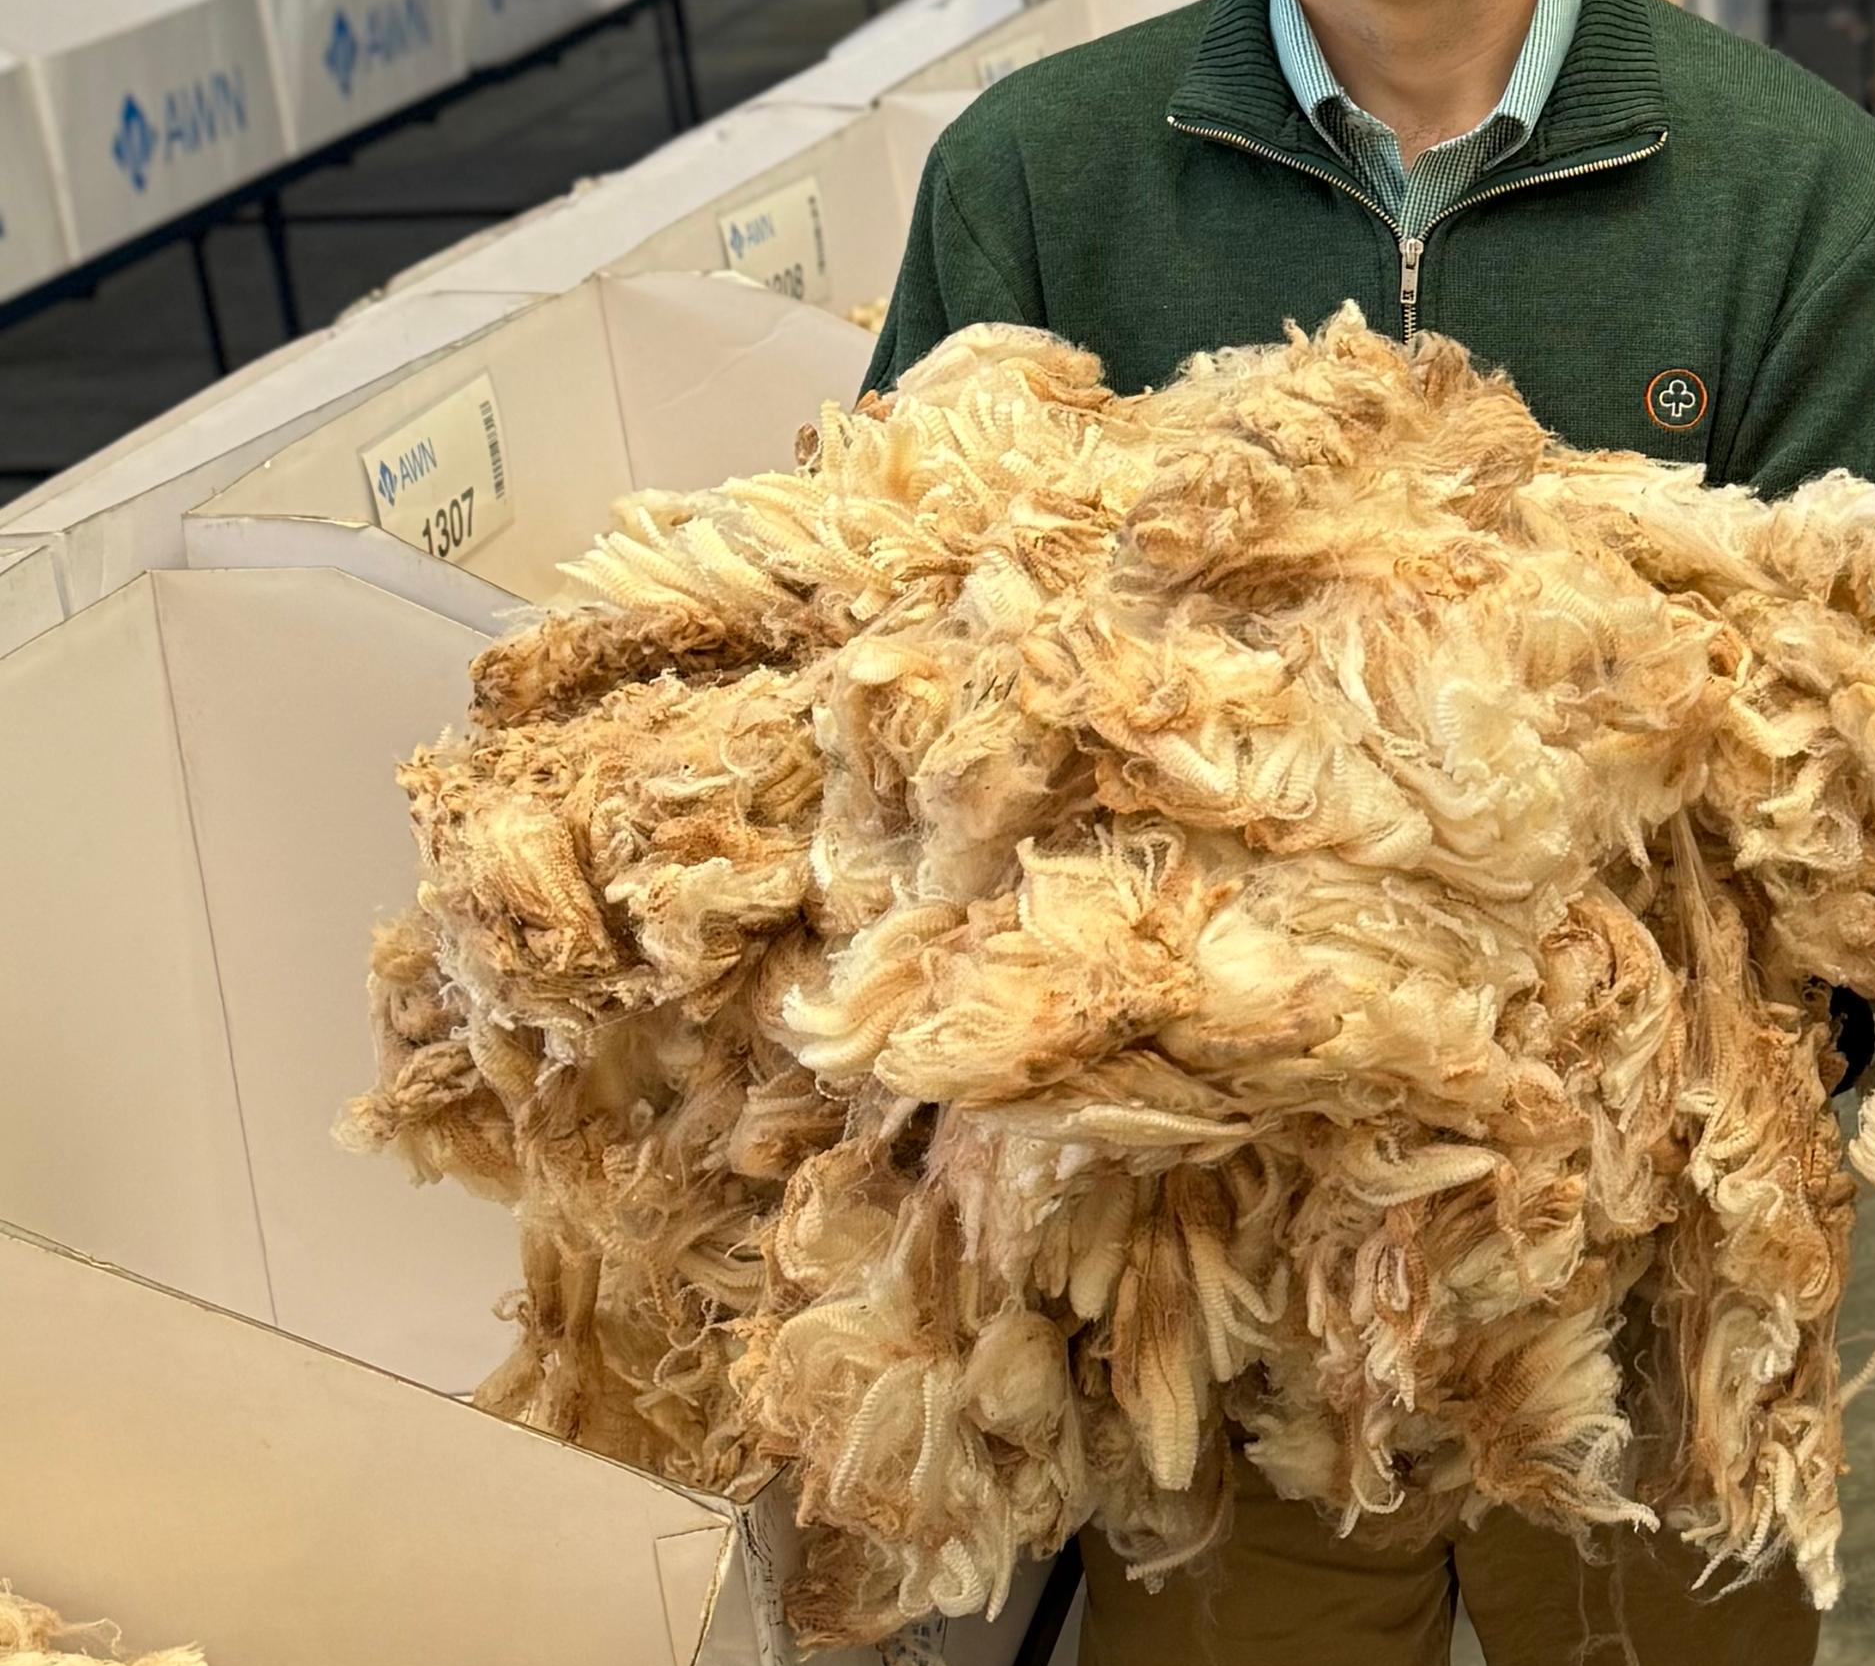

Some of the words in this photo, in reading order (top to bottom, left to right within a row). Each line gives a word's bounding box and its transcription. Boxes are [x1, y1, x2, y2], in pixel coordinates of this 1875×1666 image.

[163, 68, 248, 165] AWN
[399, 436, 438, 491] AWN
[421, 485, 475, 558] 1307
